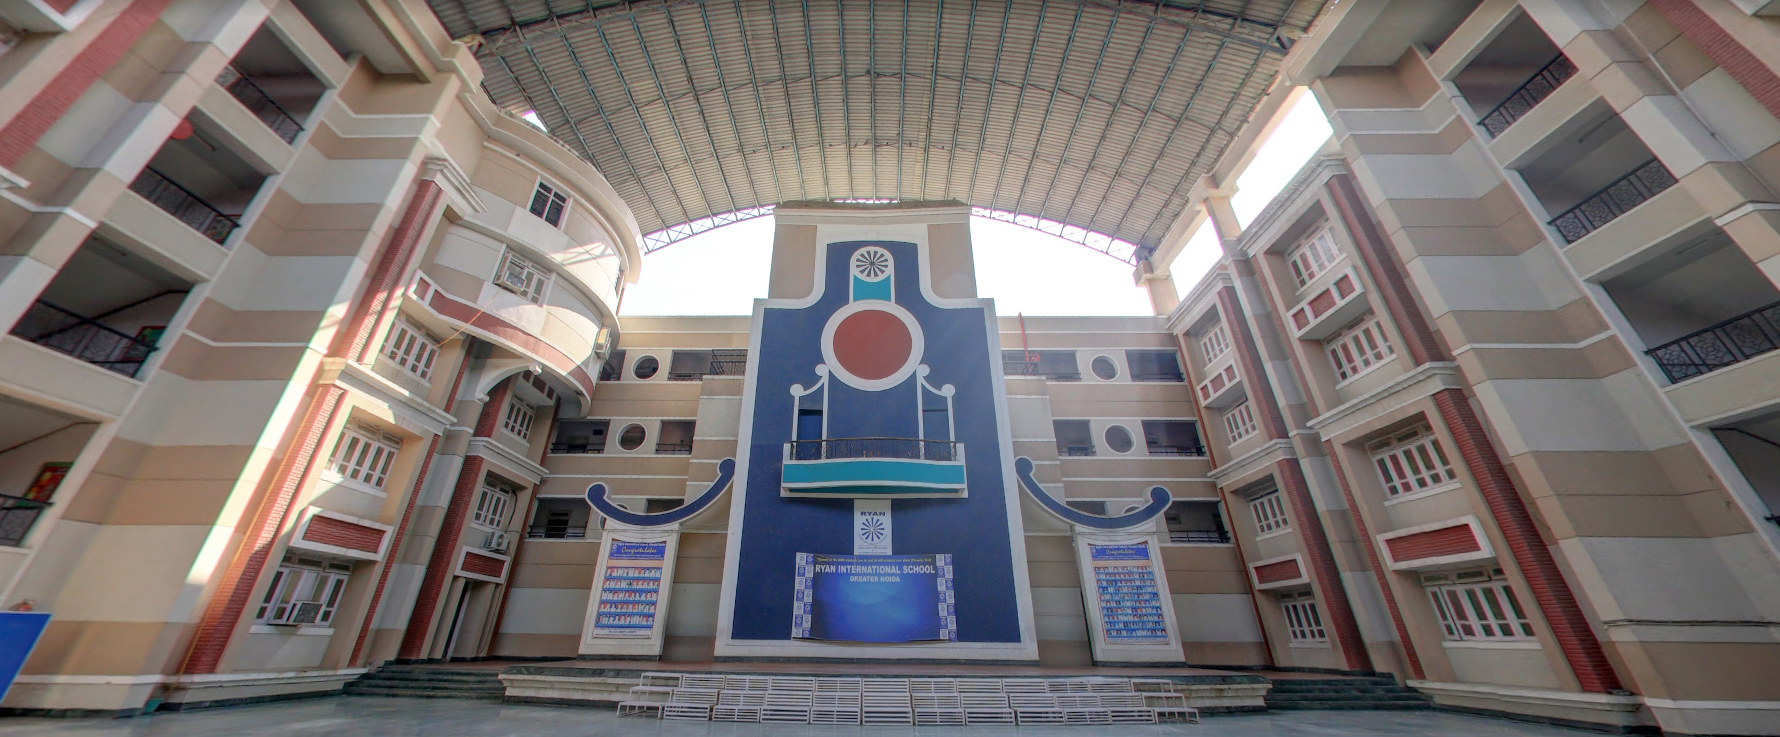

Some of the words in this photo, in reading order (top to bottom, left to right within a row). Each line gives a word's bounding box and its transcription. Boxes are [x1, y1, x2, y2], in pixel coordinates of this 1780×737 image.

[815, 564, 836, 573] RYAN
[838, 565, 901, 574] INTERNATIONAL
[902, 564, 936, 574] SCHOOL
